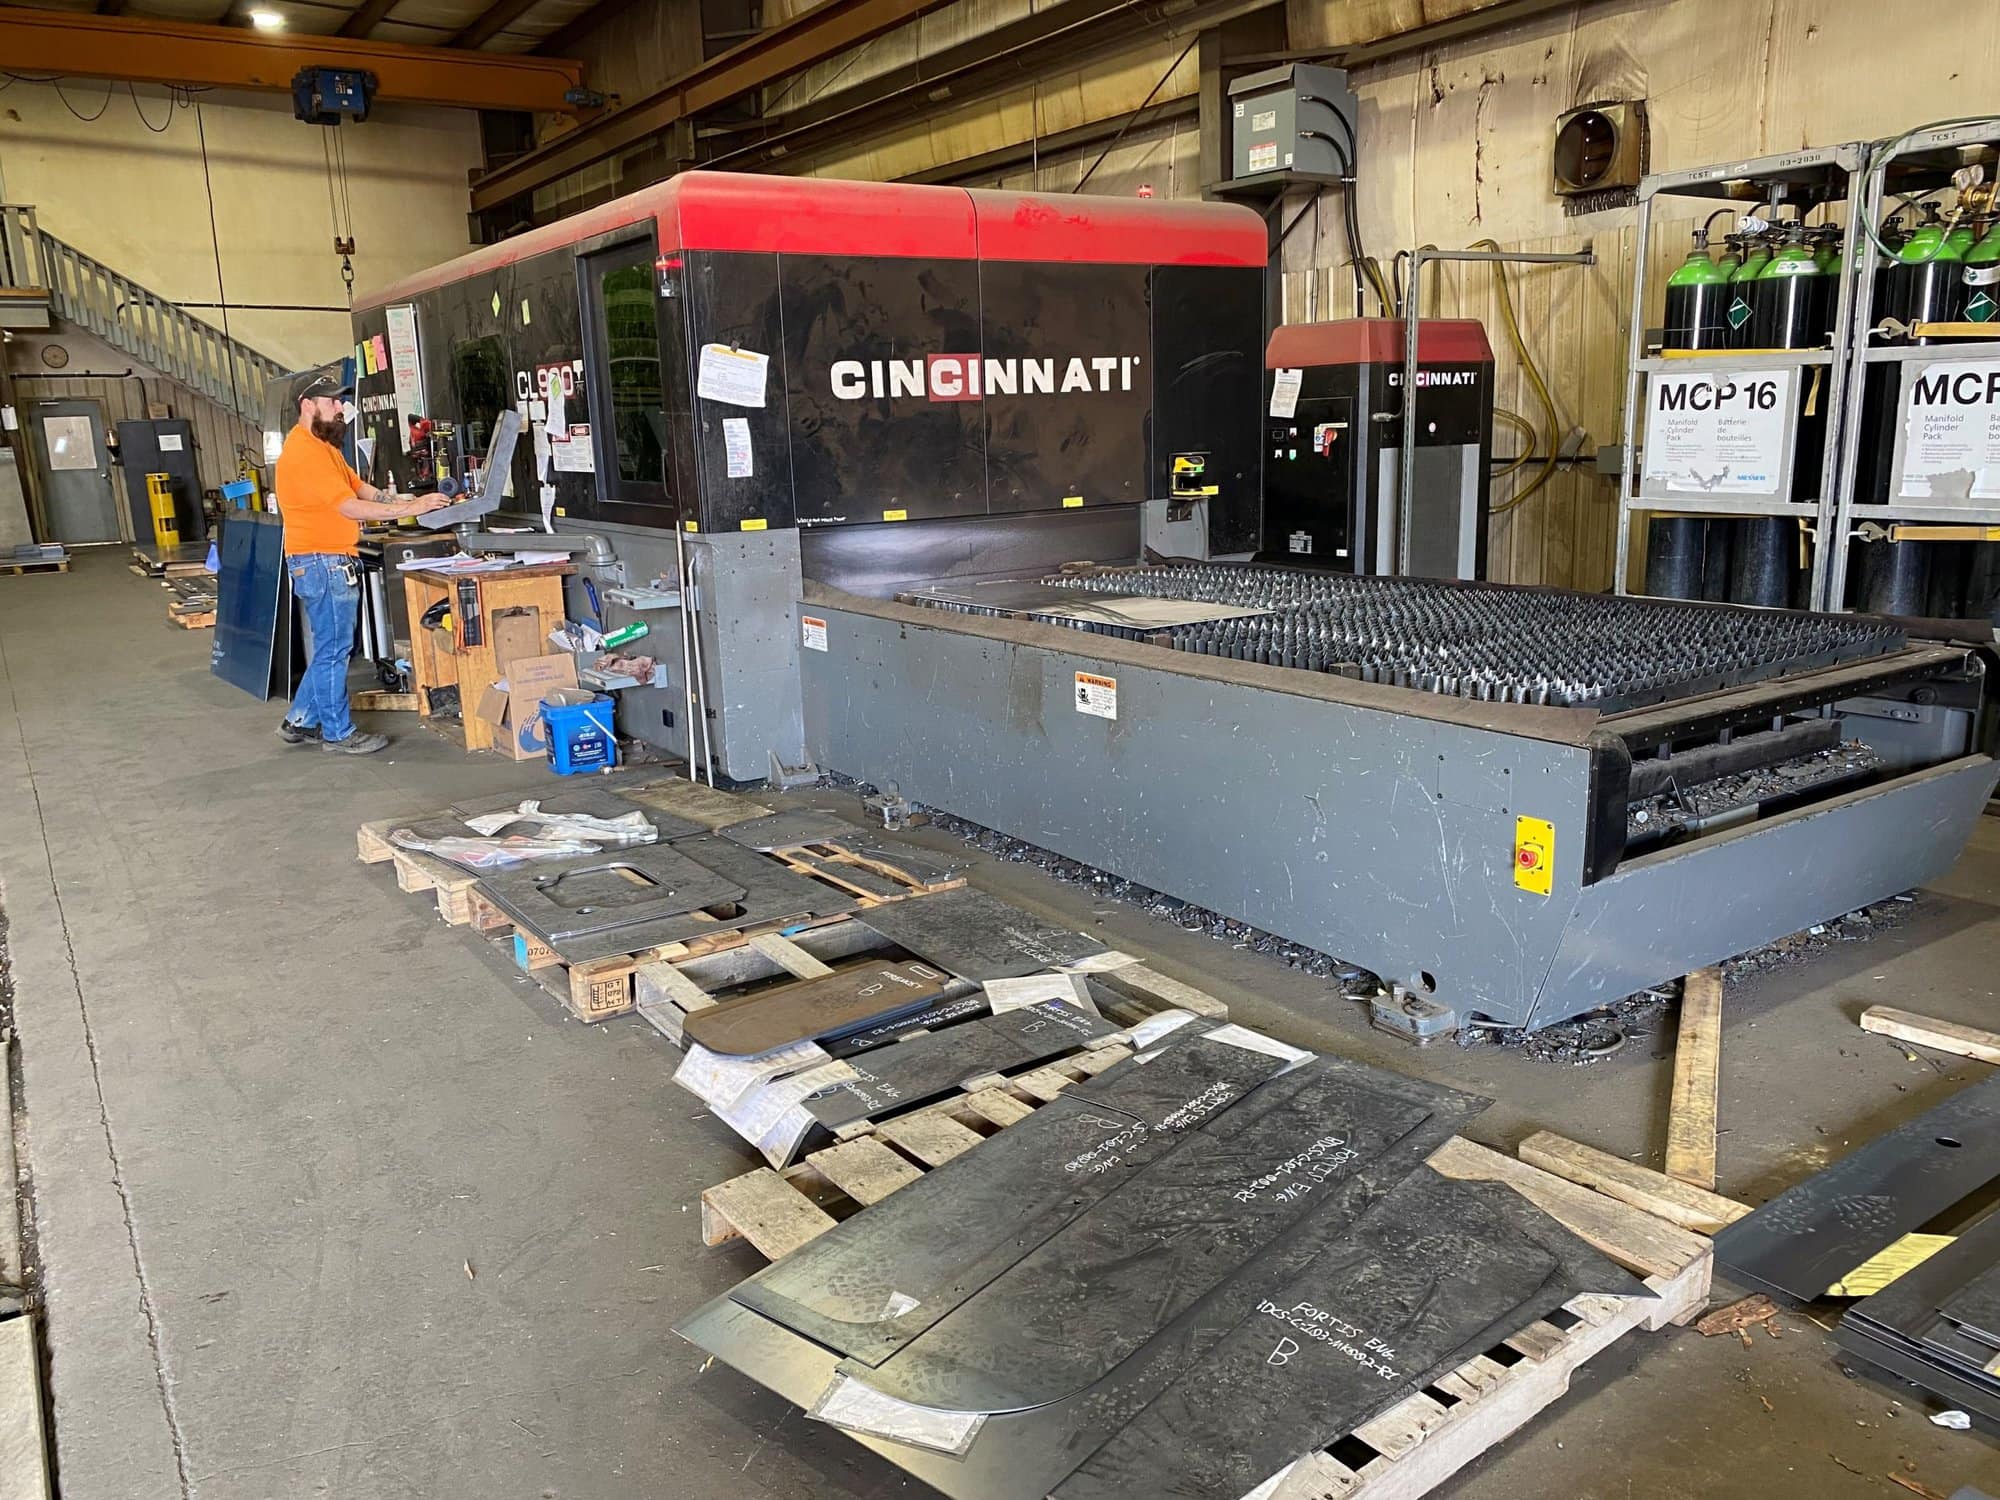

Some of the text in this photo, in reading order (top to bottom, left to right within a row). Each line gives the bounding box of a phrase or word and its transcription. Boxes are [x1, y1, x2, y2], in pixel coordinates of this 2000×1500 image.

[830, 356, 1133, 400] CINCINNATI
[1388, 372, 1475, 387] CICINNATI
[362, 393, 398, 412] CINCINNAT
[1659, 381, 1777, 411] MCP 16
[1667, 427, 1694, 435] Cylinder
[1923, 432, 1943, 440] Pack
[1924, 424, 1959, 432] Cylinder
[1307, 1147, 1360, 1183] FORTIS
[1291, 1301, 1364, 1338] FORTIS
[1266, 1336, 1300, 1366] B
